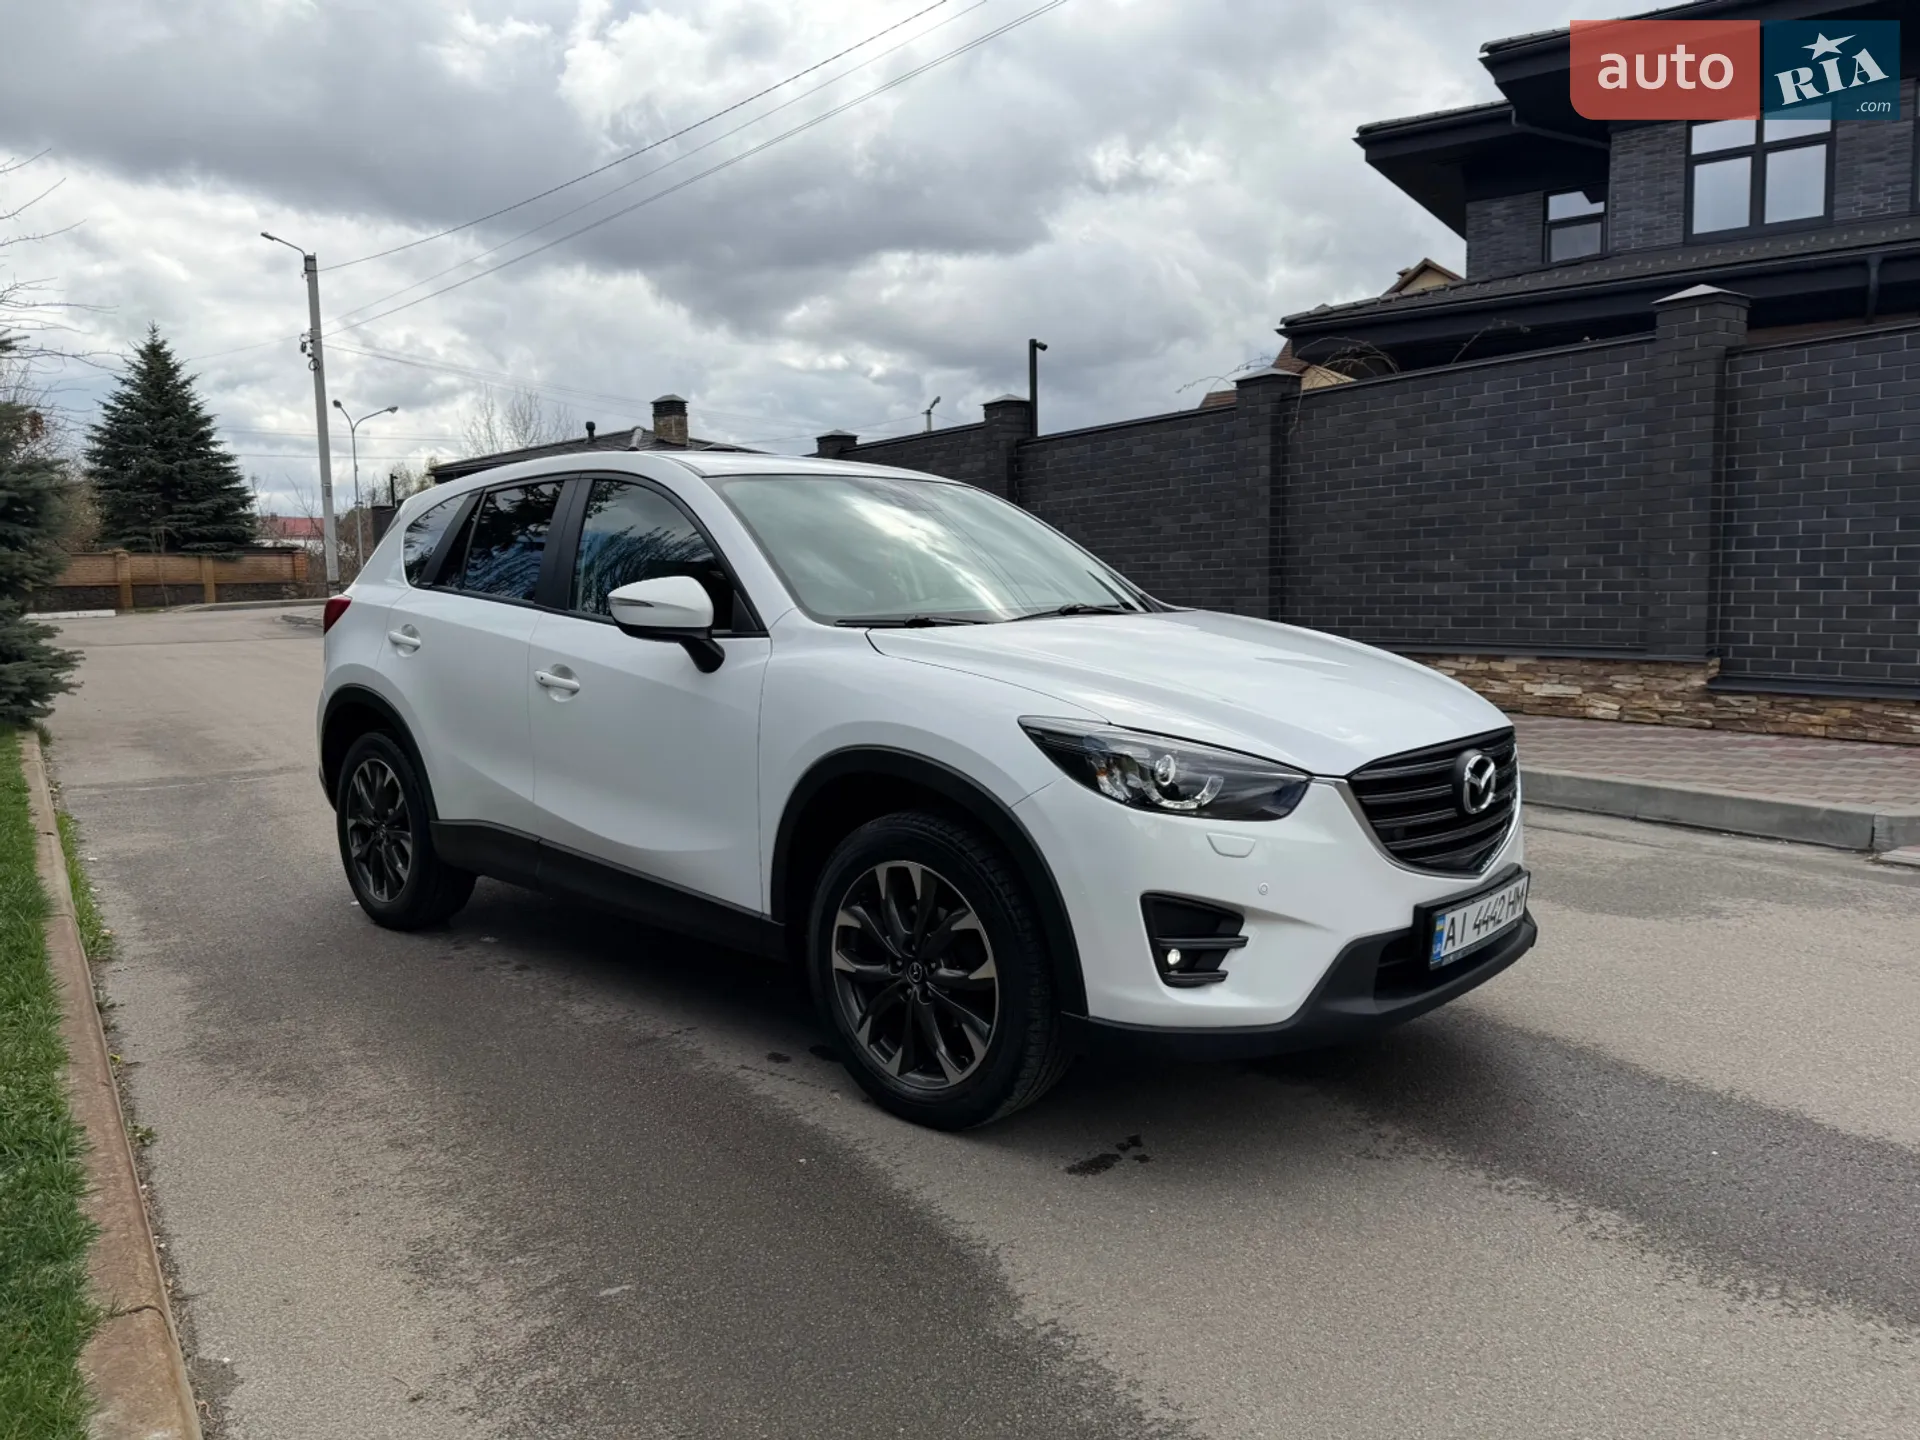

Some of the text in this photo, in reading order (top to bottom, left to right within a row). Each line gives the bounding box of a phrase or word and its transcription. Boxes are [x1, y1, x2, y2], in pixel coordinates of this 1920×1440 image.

[1444, 912, 1467, 950] AI
[1472, 894, 1505, 935] 4442
[1506, 882, 1526, 920] HM
